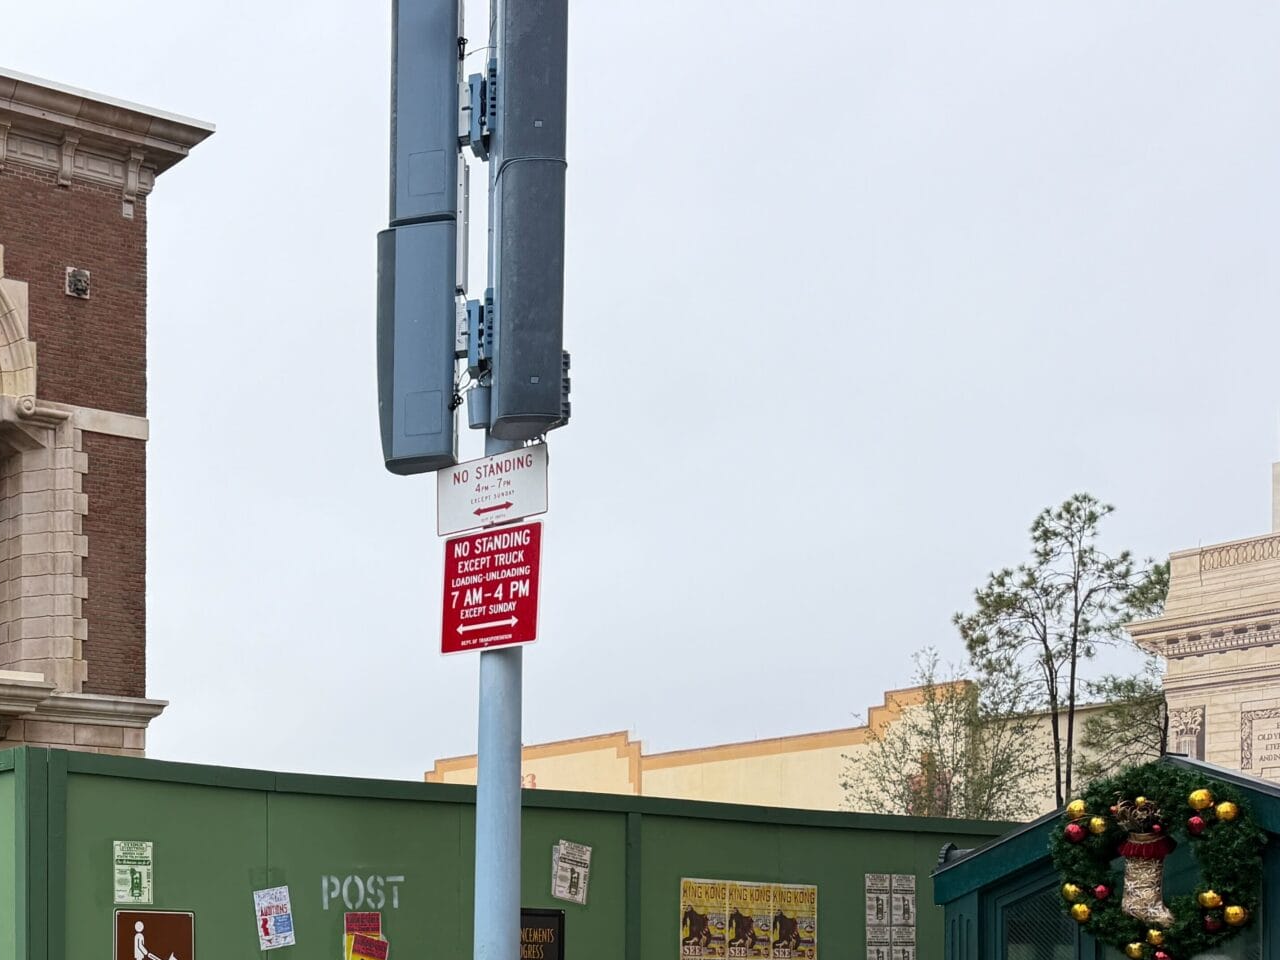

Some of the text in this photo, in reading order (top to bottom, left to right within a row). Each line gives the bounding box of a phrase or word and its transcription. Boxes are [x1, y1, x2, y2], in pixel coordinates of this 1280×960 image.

[453, 454, 533, 485] NO STANDING
[470, 490, 515, 504] EXCEPT SUNDAY
[454, 529, 531, 558] NO STANDING
[457, 550, 525, 574] EXCEPT TRUCK
[451, 565, 531, 588] LOADING-UNLOADING
[451, 591, 460, 609] 7
[509, 578, 530, 599] PM
[460, 601, 517, 620] EXCEPT SUNDAY
[321, 875, 405, 910] POST
[683, 885, 726, 899] KING KONG
[729, 887, 771, 902] KING KONG
[773, 890, 815, 904] KING KONG
[683, 946, 701, 956] SEE
[729, 947, 747, 957] SEE
[774, 948, 791, 958] SEE
